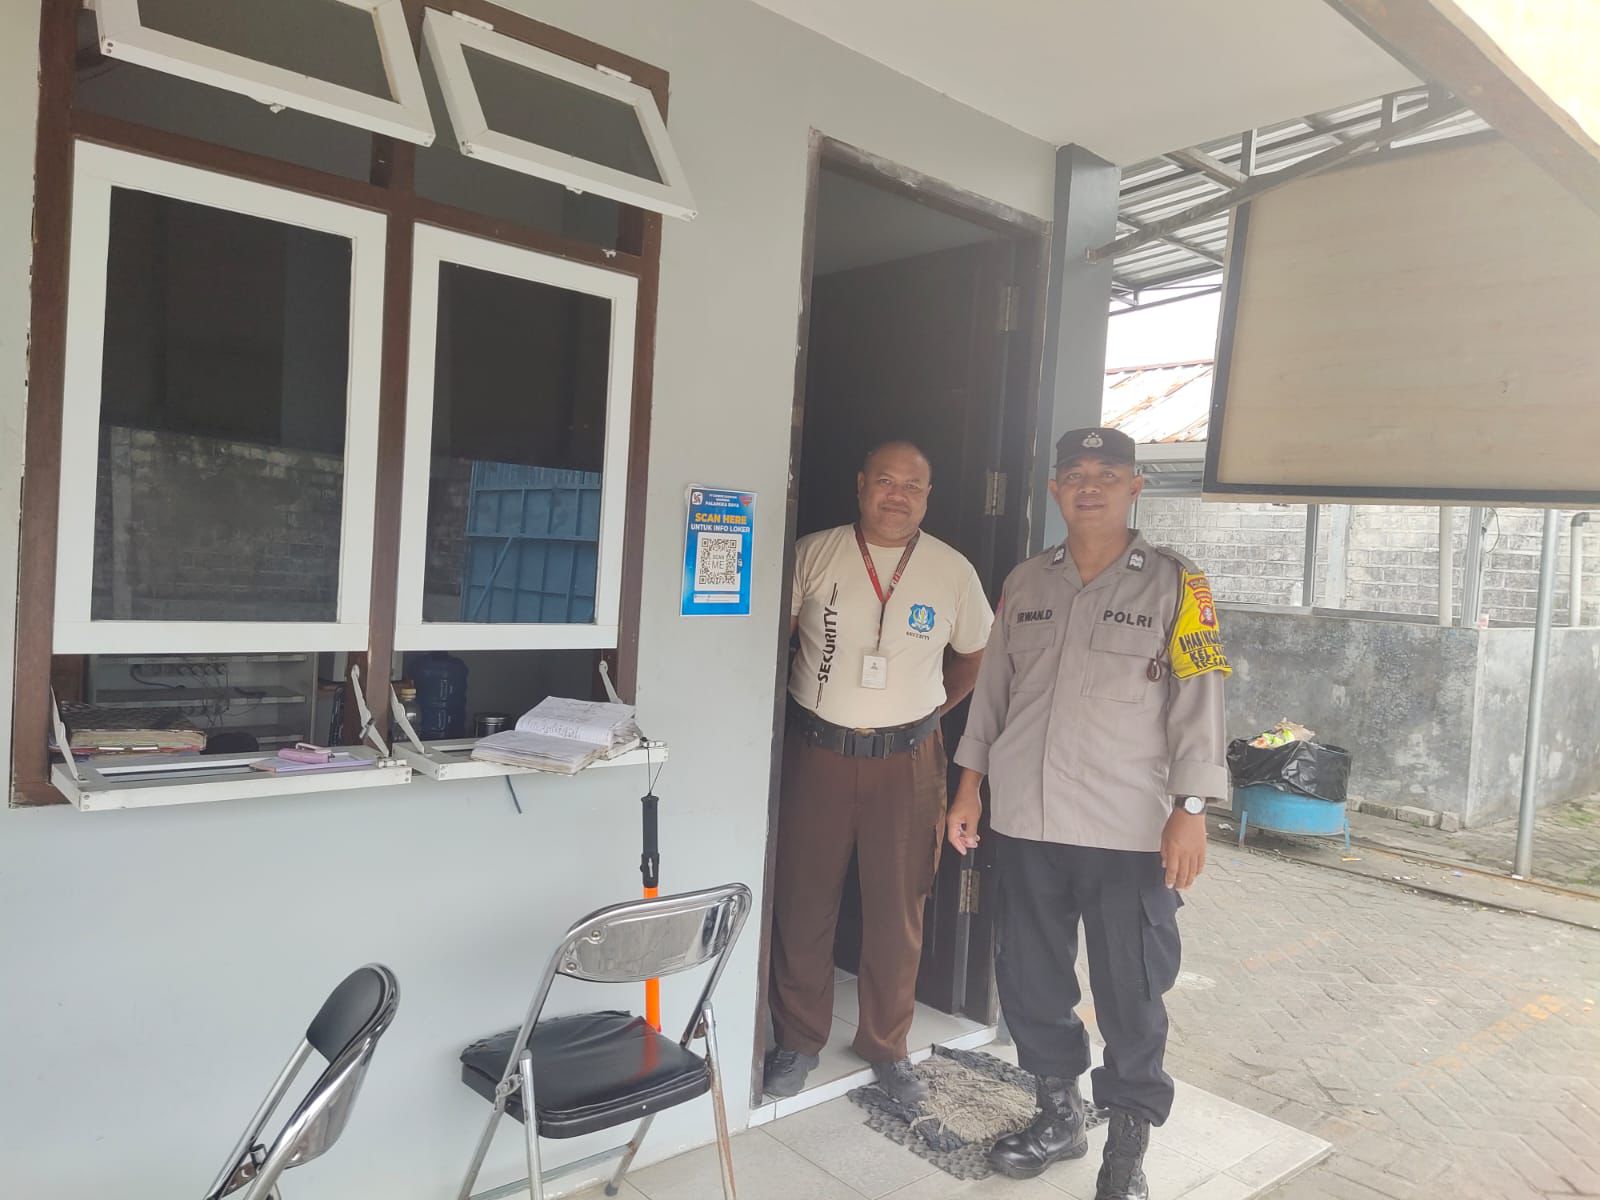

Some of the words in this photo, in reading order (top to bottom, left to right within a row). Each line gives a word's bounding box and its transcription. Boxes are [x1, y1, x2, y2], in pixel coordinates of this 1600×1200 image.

[695, 512, 721, 523] SCAN
[723, 514, 747, 525] HERE
[690, 523, 712, 531] UNTUK
[712, 560, 725, 570] ME
[1103, 610, 1153, 628] POLRI
[817, 606, 838, 683] SECURITY
